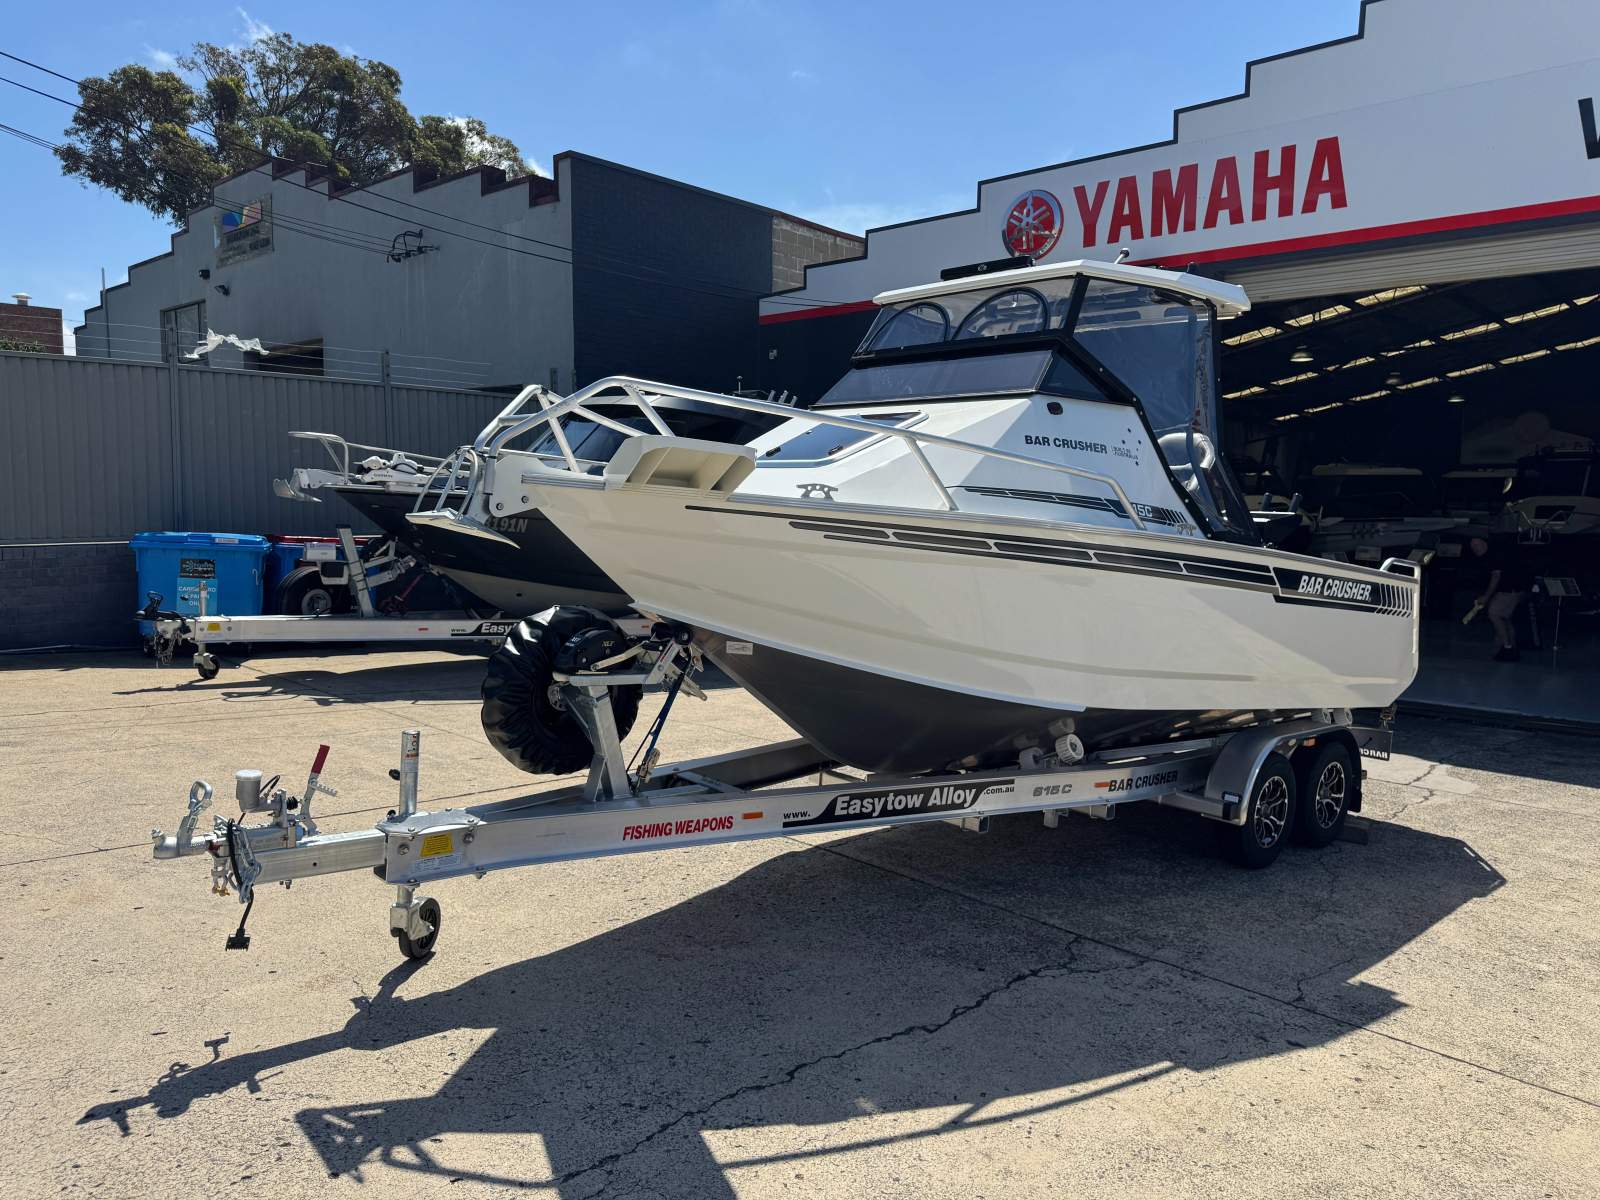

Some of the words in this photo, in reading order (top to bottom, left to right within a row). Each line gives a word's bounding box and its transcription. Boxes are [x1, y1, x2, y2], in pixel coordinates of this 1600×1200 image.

[1073, 136, 1348, 248] YAMAHA
[1024, 434, 1051, 447] BAR
[1053, 437, 1108, 454] CRUSHER
[1298, 575, 1323, 595] BAR
[1323, 578, 1372, 601] CRUSHER
[1108, 777, 1133, 793] BAR
[1135, 770, 1179, 789] CRUSHER
[782, 811, 811, 820] www.
[834, 790, 923, 817] Easytow
[927, 785, 977, 808] Alloy
[983, 785, 1015, 796] .com.au
[622, 821, 673, 841] FISHING
[675, 815, 734, 836] WEAPONS
